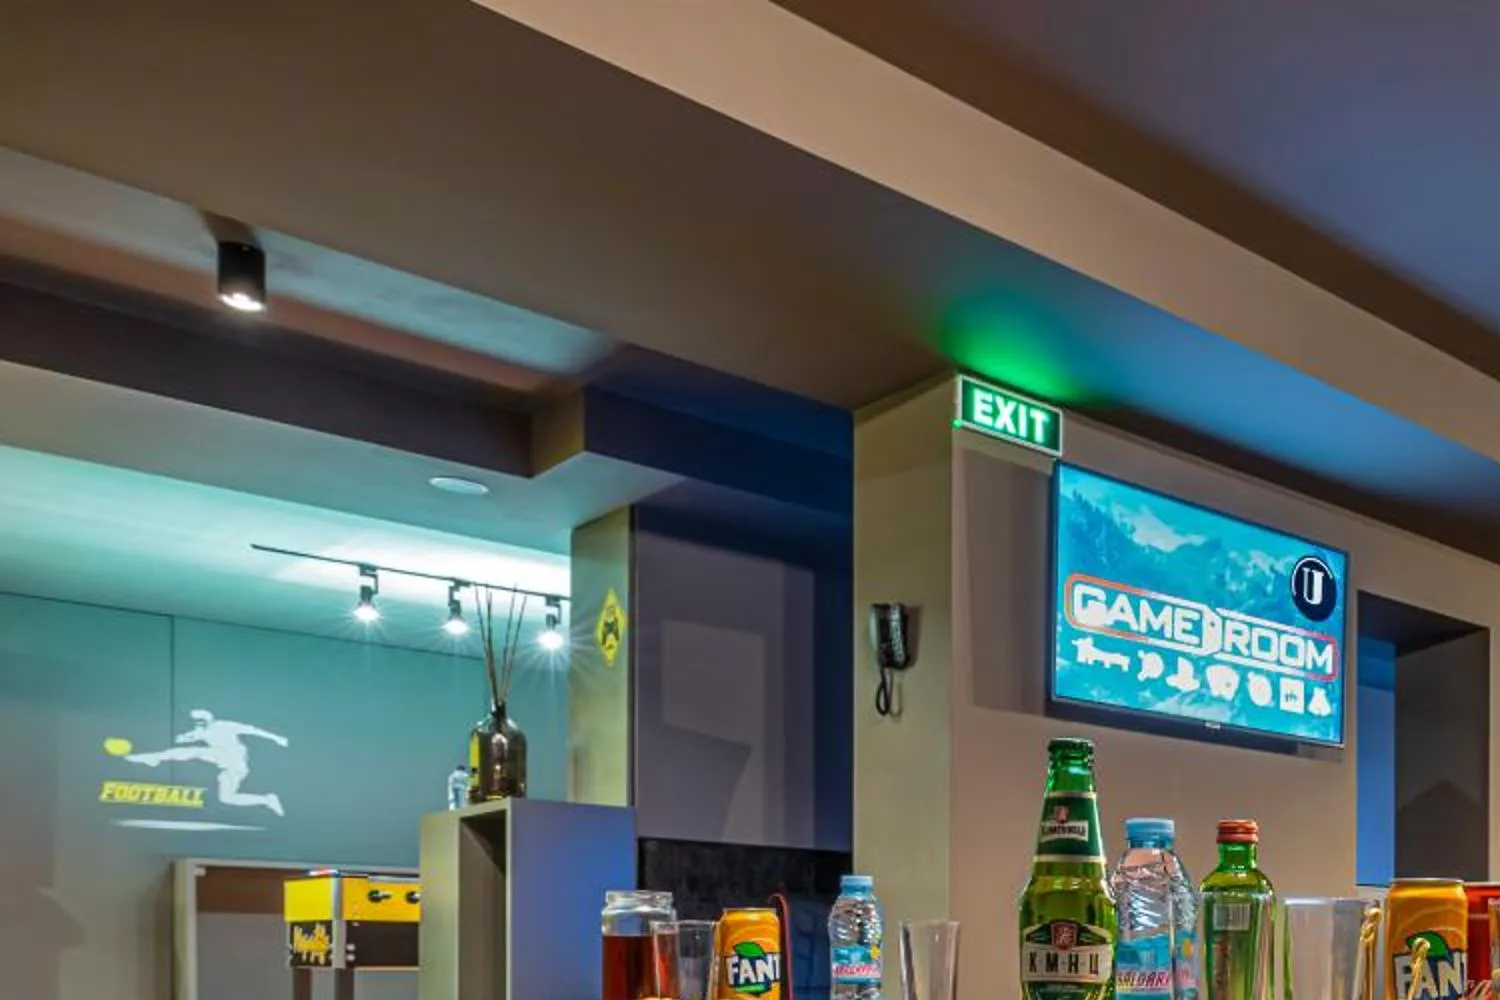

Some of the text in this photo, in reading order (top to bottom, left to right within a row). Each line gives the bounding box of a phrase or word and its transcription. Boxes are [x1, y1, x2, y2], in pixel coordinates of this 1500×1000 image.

[973, 387, 1050, 444] EXIT
[1073, 583, 1334, 675] GAME ROOM
[99, 781, 207, 808] FOOTBALL
